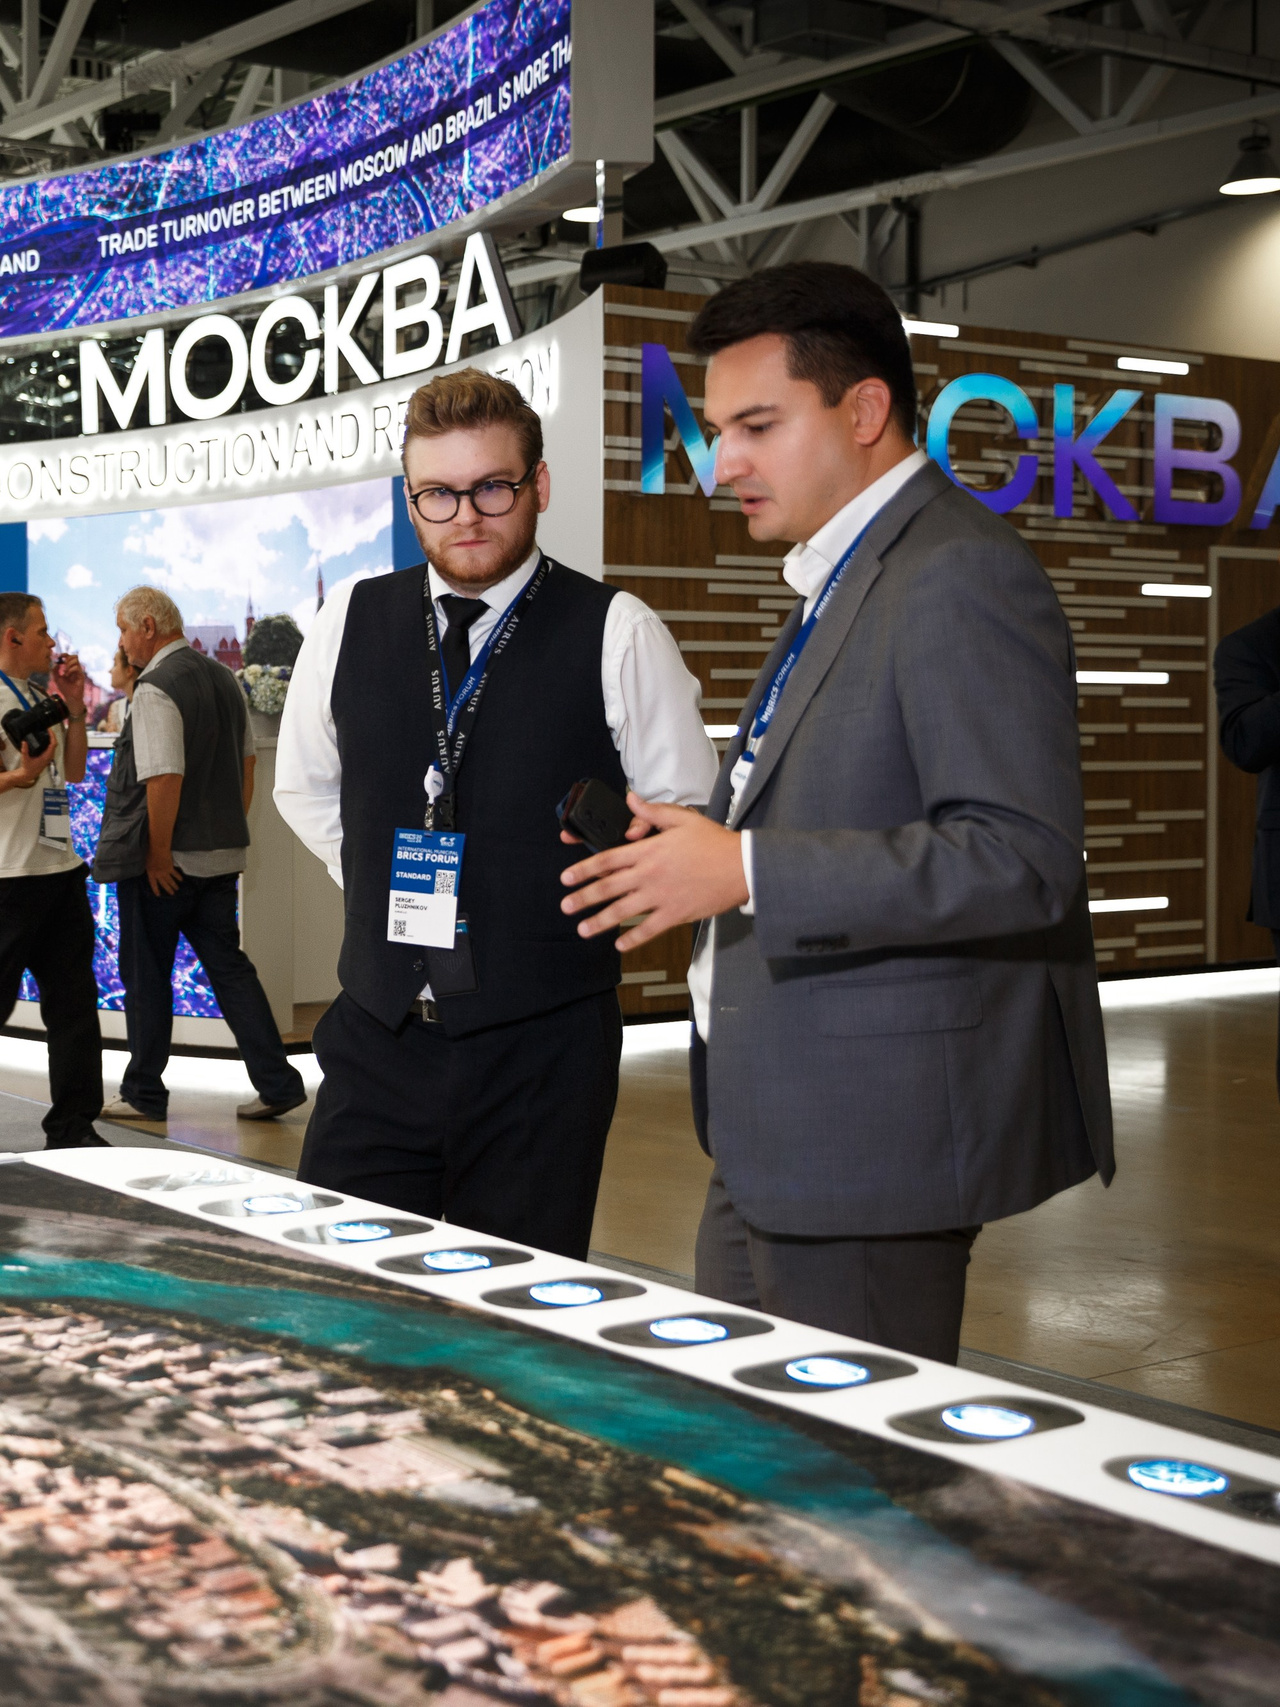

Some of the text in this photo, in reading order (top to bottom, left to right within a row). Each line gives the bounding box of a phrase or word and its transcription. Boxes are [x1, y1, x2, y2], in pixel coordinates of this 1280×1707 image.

[97, 223, 158, 258] TRADE
[161, 197, 255, 244] TURNOVER
[258, 170, 337, 219] BETWEEN
[339, 139, 409, 192] MOSCOW
[410, 122, 443, 163] AND
[445, 95, 496, 145] BRAZIL
[497, 81, 512, 112] IS
[512, 50, 551, 103] MORE
[78, 231, 516, 435] МОСКВА
[290, 412, 360, 469] AND
[526, 564, 546, 601] AURUS
[425, 613, 437, 651] AURUS
[494, 614, 520, 655] AURUS
[431, 669, 442, 710] AURUS
[446, 676, 476, 739] MBRICS FORUM
[760, 653, 795, 723] IMBRICS FORUM
[437, 729, 451, 774] AURUS
[395, 871, 432, 881] STANDARD
[396, 850, 459, 865] BRICS FORUM
[395, 903, 428, 911] PLUZHNIKOV
